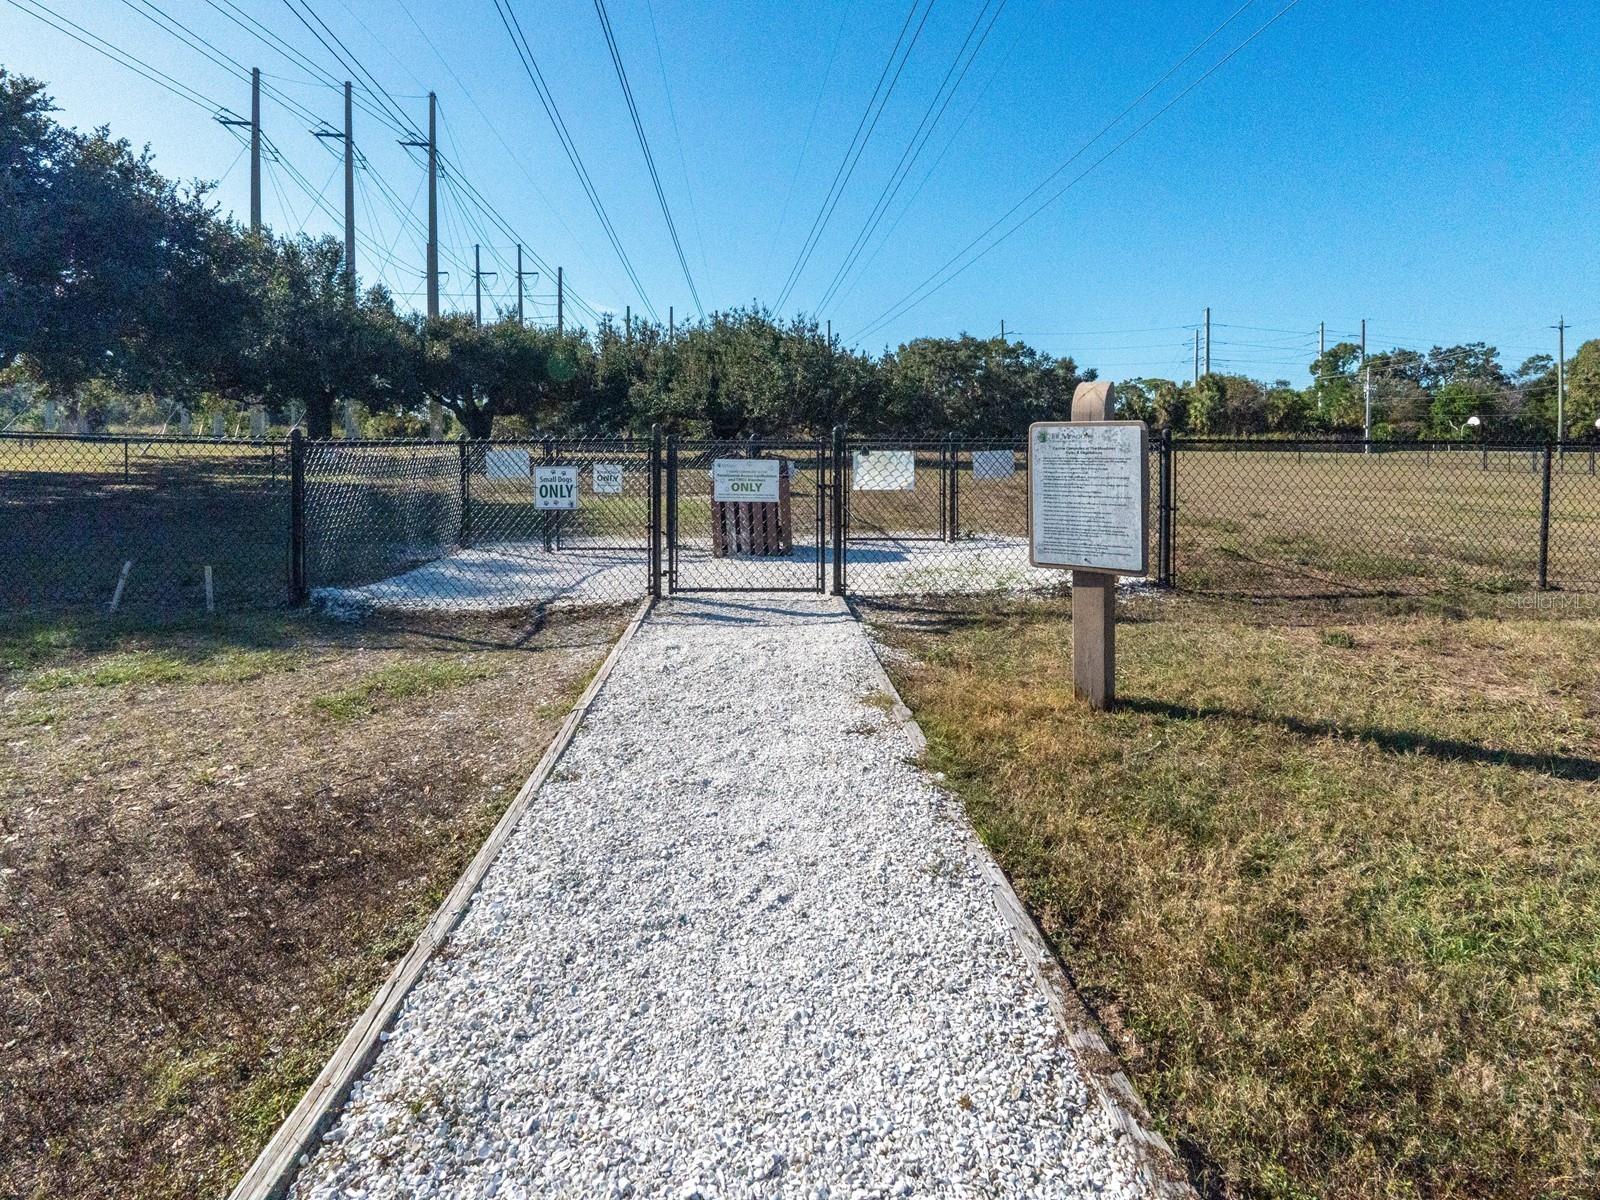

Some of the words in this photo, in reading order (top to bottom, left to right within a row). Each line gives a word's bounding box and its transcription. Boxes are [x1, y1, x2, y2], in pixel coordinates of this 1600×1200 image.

[557, 476, 572, 484] Dogs
[539, 484, 573, 498] ONLY
[731, 482, 762, 492] ONLY
